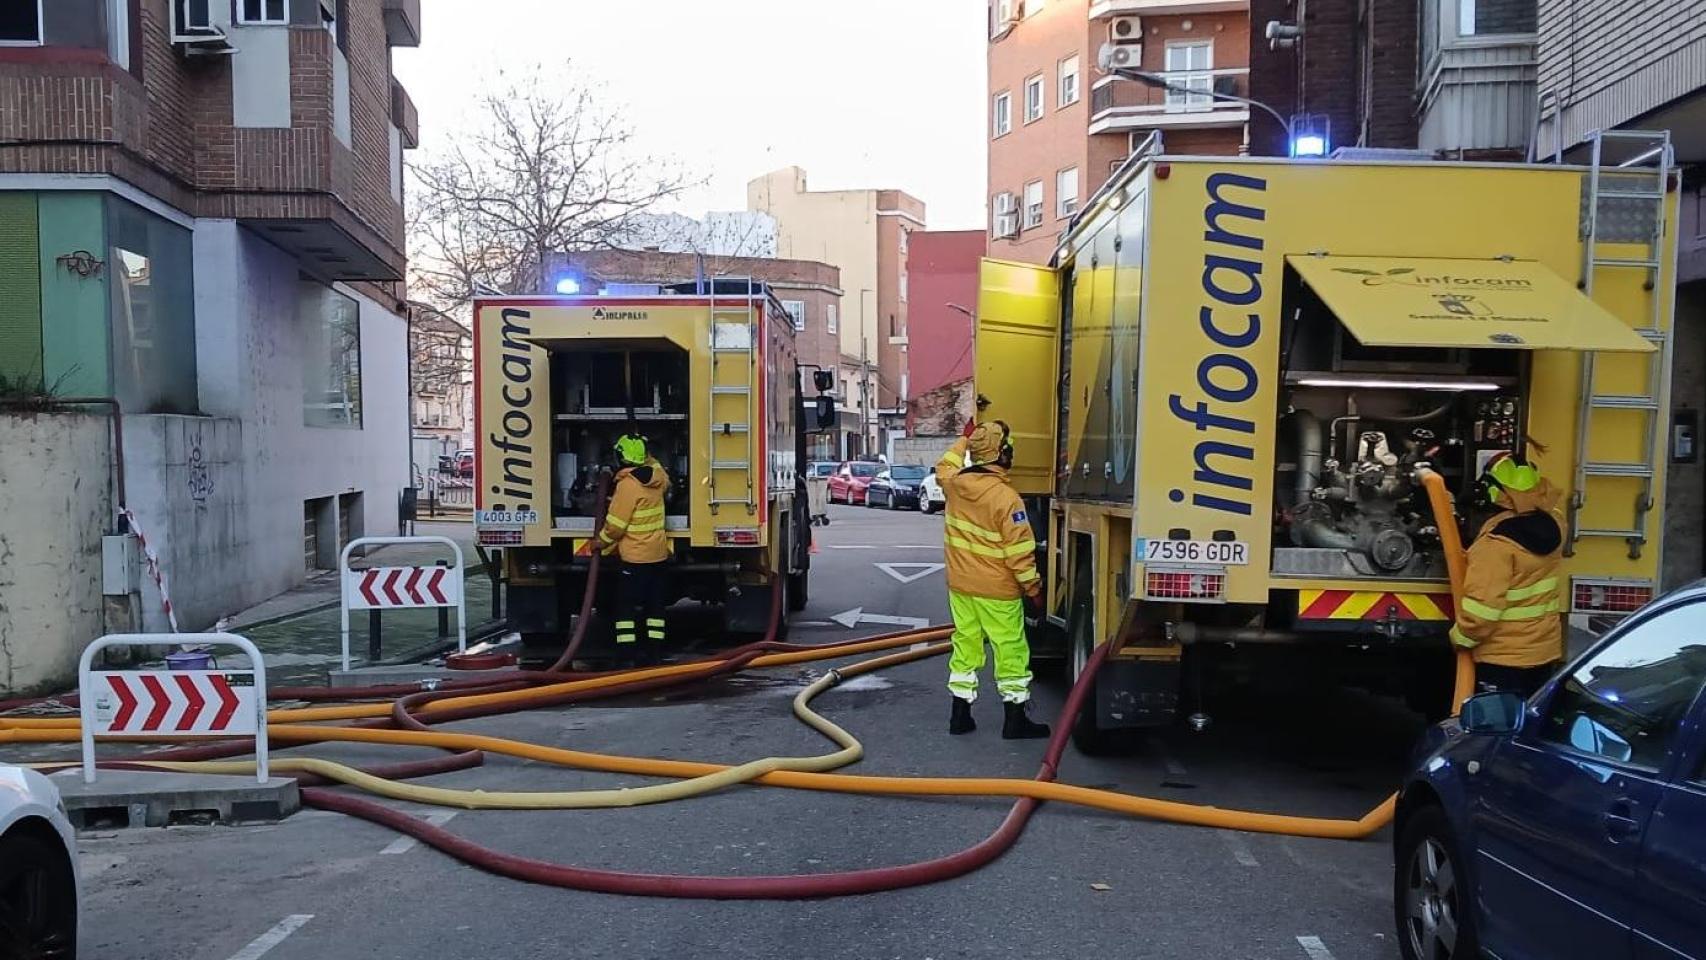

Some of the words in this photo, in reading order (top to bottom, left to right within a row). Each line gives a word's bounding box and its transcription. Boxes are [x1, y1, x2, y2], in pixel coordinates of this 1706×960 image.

[1415, 275, 1532, 286] infocam
[1168, 172, 1267, 516] infocam
[490, 307, 532, 500] infocam
[483, 511, 512, 522] 4003
[514, 511, 537, 522] GFR
[1149, 541, 1201, 560] 7596
[1206, 542, 1245, 562] GDR
